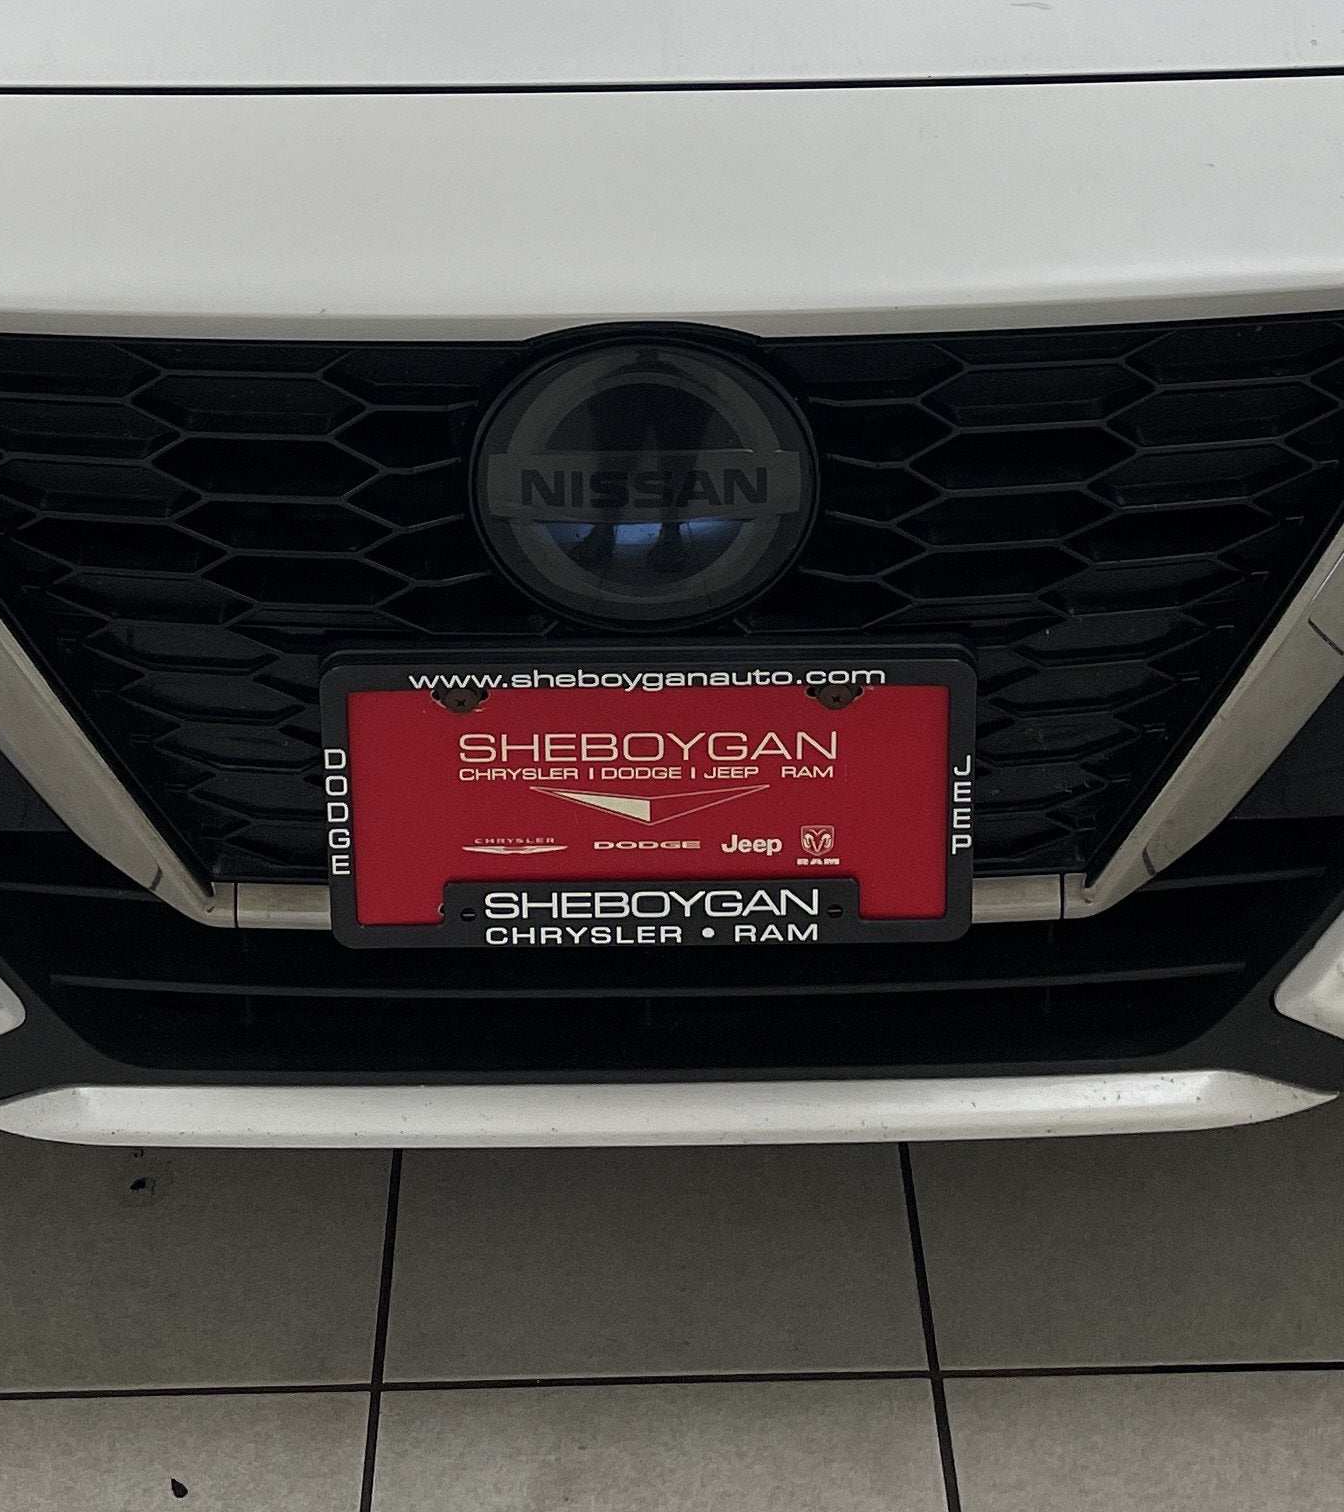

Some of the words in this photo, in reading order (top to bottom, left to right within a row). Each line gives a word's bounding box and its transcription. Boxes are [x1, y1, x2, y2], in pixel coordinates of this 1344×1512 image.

[520, 466, 768, 509] NISSAN
[408, 668, 886, 692] www.sheboyganauto.com
[459, 731, 837, 764] SHEBOYGAN
[459, 767, 579, 781] CHRYSLER
[601, 766, 682, 780] DODGE
[703, 766, 759, 779] JEEP
[781, 765, 834, 779] RAM
[324, 748, 351, 875] DODGE
[952, 754, 972, 855] JEEP
[593, 840, 701, 850] DODGE
[721, 834, 783, 856] Jeep
[797, 858, 840, 866] RAM
[484, 888, 819, 919] SHEBOYGAN
[485, 926, 682, 945] CHRYSLER
[734, 923, 818, 942] RAM
